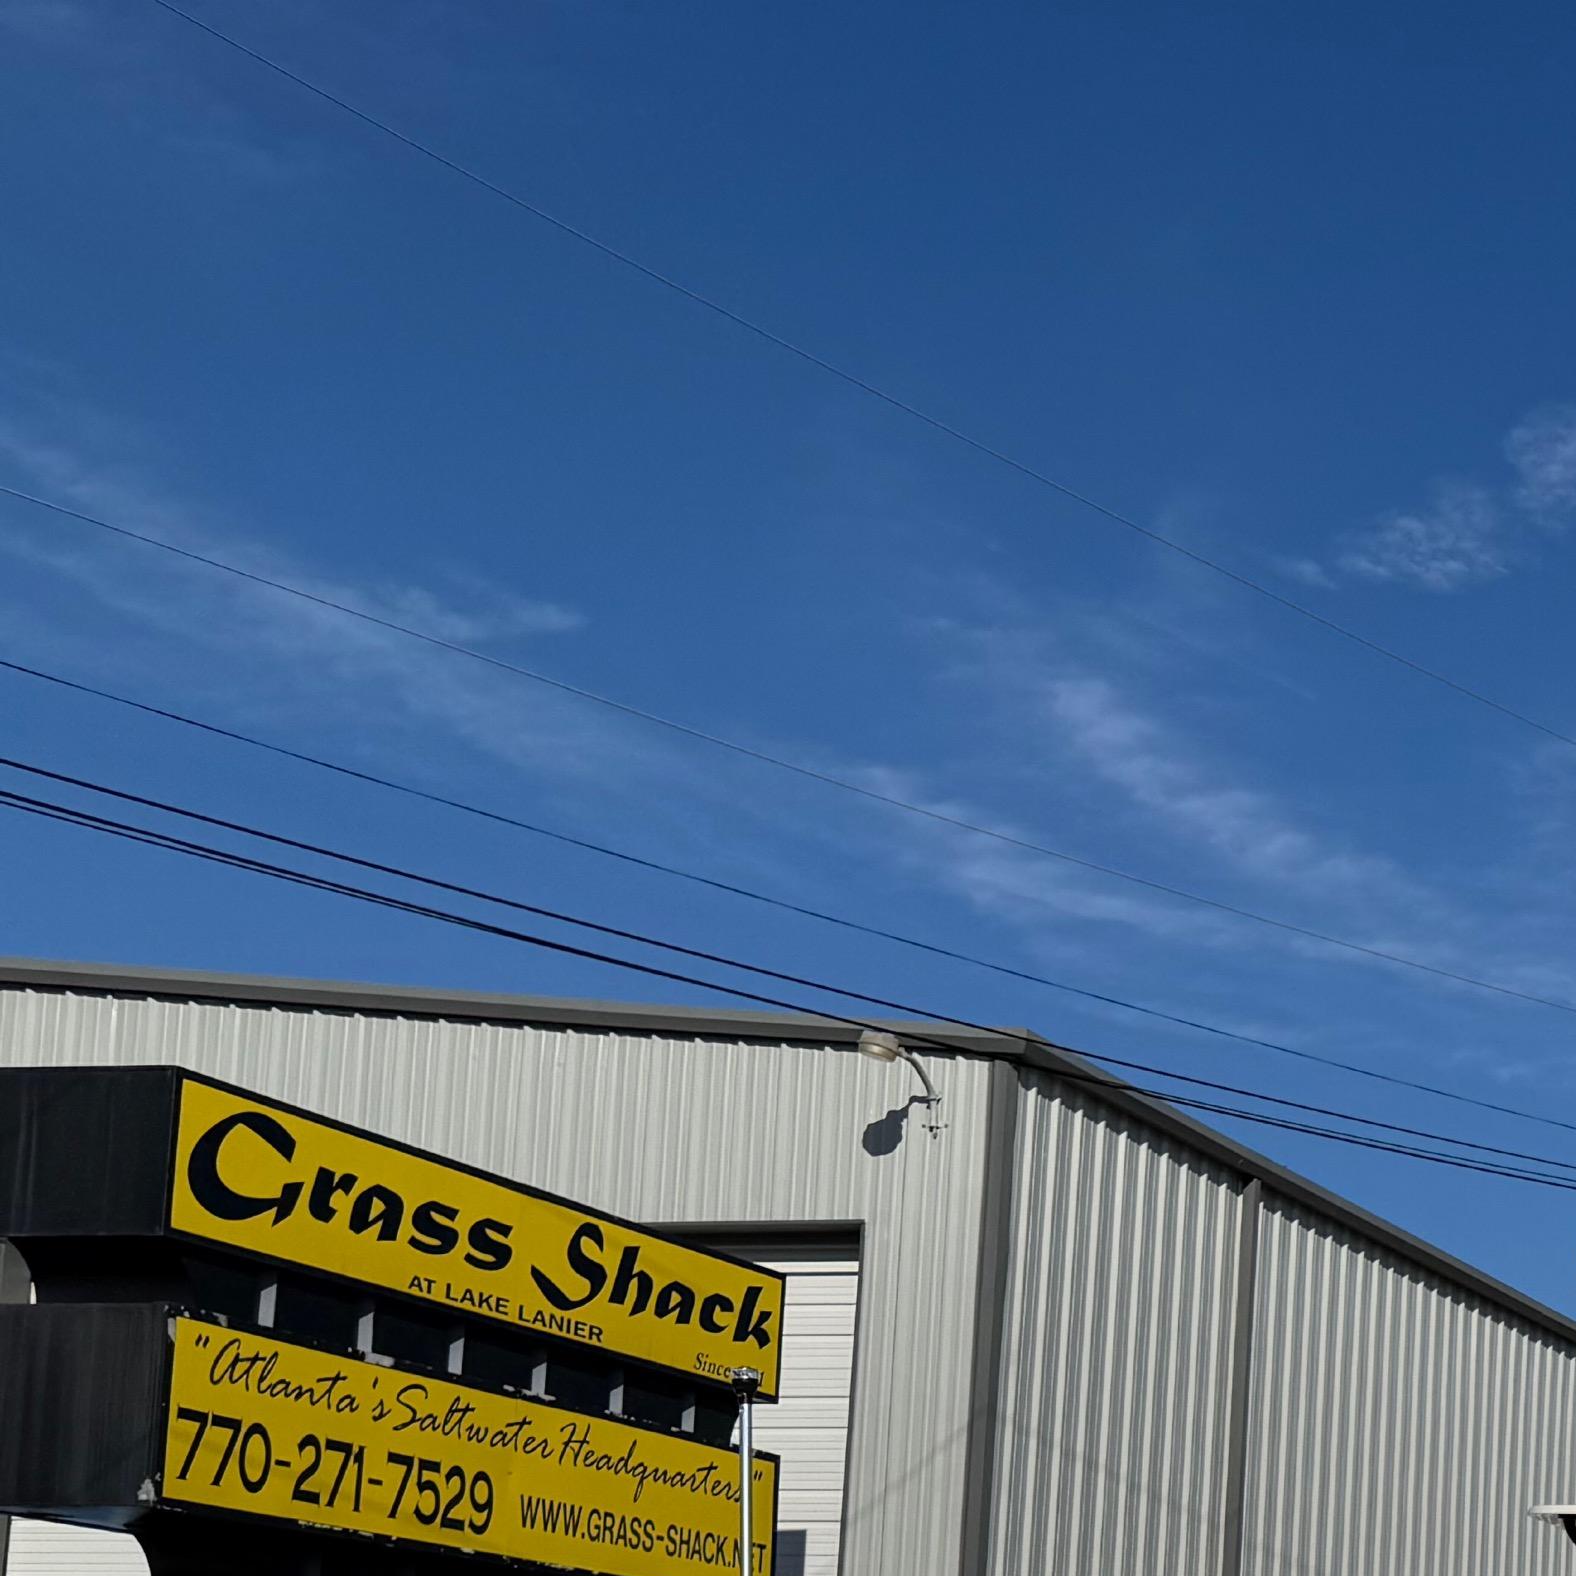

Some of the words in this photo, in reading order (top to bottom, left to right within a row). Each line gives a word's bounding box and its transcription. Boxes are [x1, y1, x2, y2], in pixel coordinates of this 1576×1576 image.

[187, 1111, 513, 1271] Grass
[530, 1221, 772, 1349] Shack
[408, 1275, 437, 1294] AT
[445, 1282, 510, 1316] LAKE
[517, 1304, 604, 1343] LANIER
[694, 1352, 731, 1379] Since
[393, 1383, 556, 1459] Saltwater
[176, 1404, 495, 1536] 770-271-7529
